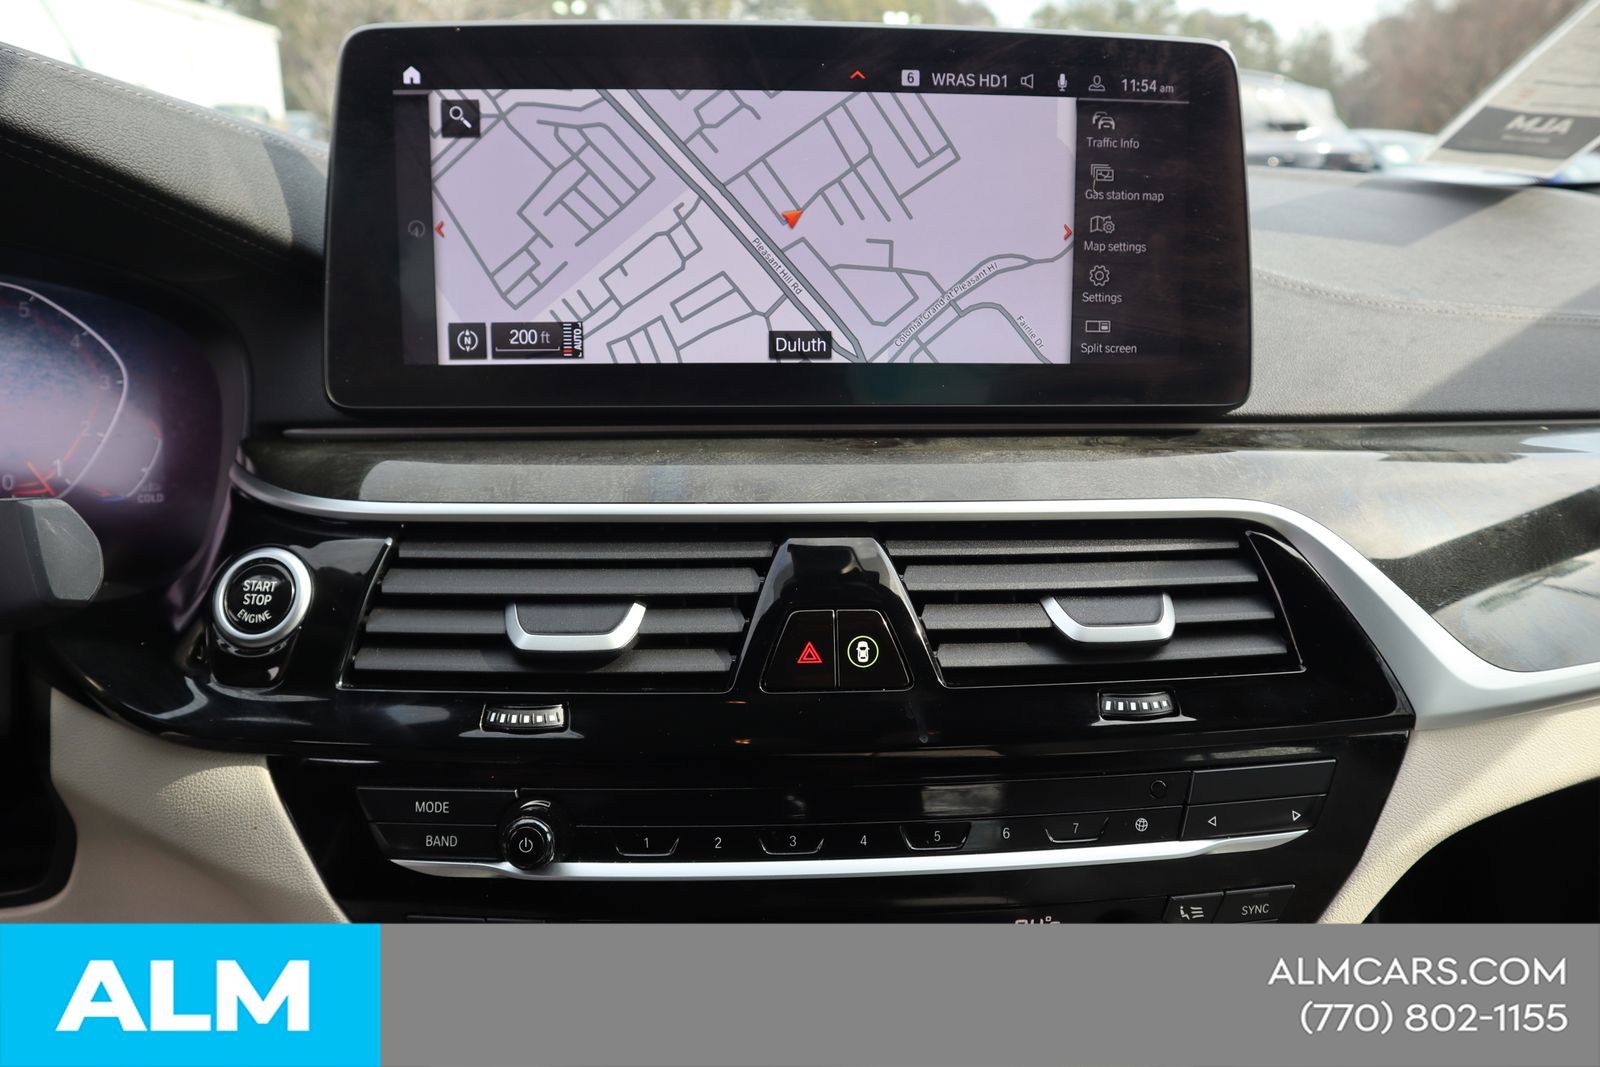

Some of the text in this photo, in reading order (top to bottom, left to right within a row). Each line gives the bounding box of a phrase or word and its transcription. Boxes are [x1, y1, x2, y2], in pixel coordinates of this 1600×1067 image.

[906, 72, 916, 84] 6
[931, 73, 1008, 87] WRAS HD1
[1121, 79, 1175, 93] 11:54 am
[1086, 137, 1140, 149] Traffic Info
[1085, 189, 1164, 203] Gas station map
[1084, 241, 1147, 254] Map settings
[752, 237, 803, 295] Pleasant Hill Rd
[1082, 292, 1122, 304] Settings
[18, 301, 30, 318] 5
[894, 317, 923, 348] Colonial
[922, 298, 946, 321] Grand
[946, 289, 955, 301] at
[953, 269, 987, 295] Pleasant
[509, 329, 551, 344] 200 ft
[1016, 315, 1044, 349] Fairlie Dr
[70, 334, 81, 348] 4
[573, 328, 583, 350] AUTO
[775, 337, 827, 353] Duluth
[1080, 342, 1138, 355] Split screen
[100, 375, 110, 390] 3
[53, 459, 62, 476] 1
[1, 474, 14, 491] 0
[242, 579, 278, 592] START
[242, 593, 273, 606] STOP
[236, 608, 273, 624] ENGINE
[414, 801, 450, 814] MODE
[1002, 827, 1011, 839] 6
[1072, 822, 1080, 833] 7
[425, 835, 458, 848] BAND
[714, 836, 722, 849] 2
[789, 835, 797, 847] 3
[859, 834, 867, 846] 4
[933, 830, 941, 842] 5
[1241, 903, 1270, 916] SYNC
